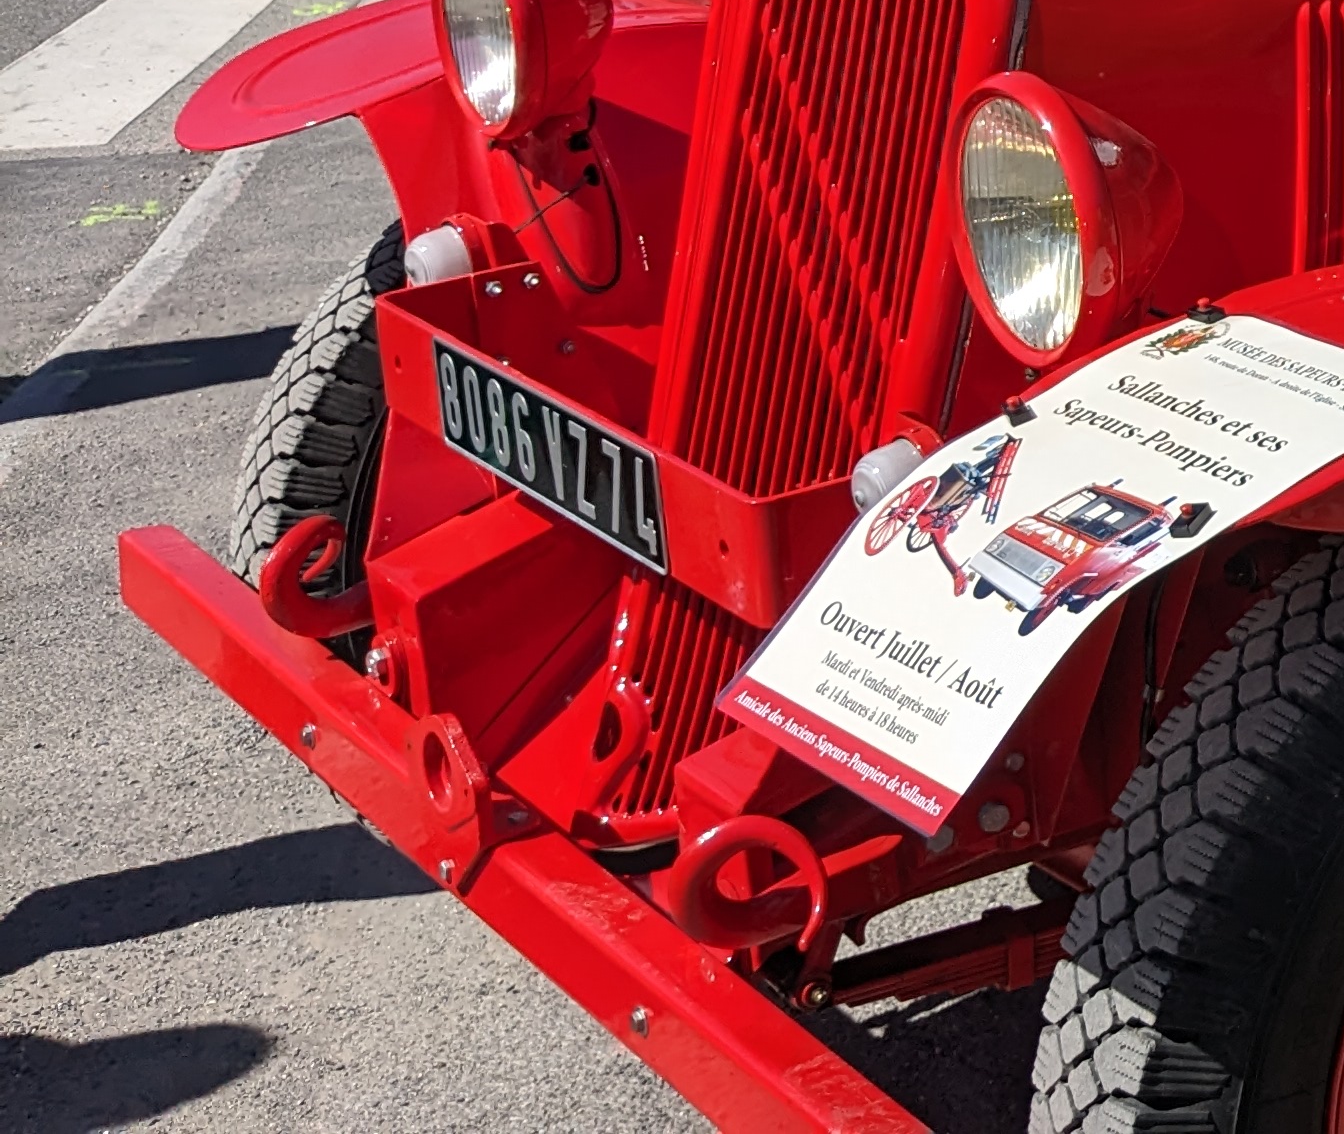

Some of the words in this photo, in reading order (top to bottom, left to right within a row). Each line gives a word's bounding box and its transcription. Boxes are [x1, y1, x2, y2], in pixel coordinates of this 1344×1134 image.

[1217, 337, 1261, 361] MUSÉE
[1259, 353, 1290, 370] DES
[1219, 360, 1239, 372] route
[1279, 381, 1301, 393] droite
[1053, 398, 1254, 487] Sapeurs-Pompiers
[1108, 375, 1224, 426] Sallanches
[1220, 419, 1253, 437] et
[1245, 430, 1289, 453] ses
[440, 352, 536, 483] 8086
[542, 405, 596, 520] VZ
[601, 438, 657, 556] 74
[820, 601, 887, 650] Ouvert
[876, 630, 943, 678] Juillet
[935, 659, 959, 684] /
[947, 666, 1004, 709] Août
[821, 650, 854, 675] Mardi
[848, 667, 862, 680] et
[860, 669, 902, 702] Vendredi
[898, 692, 950, 726] après-midi
[815, 679, 830, 696] de
[828, 686, 844, 703] 14
[839, 689, 870, 718] heures
[868, 706, 879, 722] à
[875, 711, 889, 728] 18
[886, 714, 920, 745] heures
[734, 690, 771, 717] Amicale
[769, 708, 783, 727] des
[781, 717, 817, 746] Anciens
[815, 734, 889, 786] Sapeurs-Pompiers
[886, 776, 902, 792] de
[899, 780, 943, 817] Sallanches
